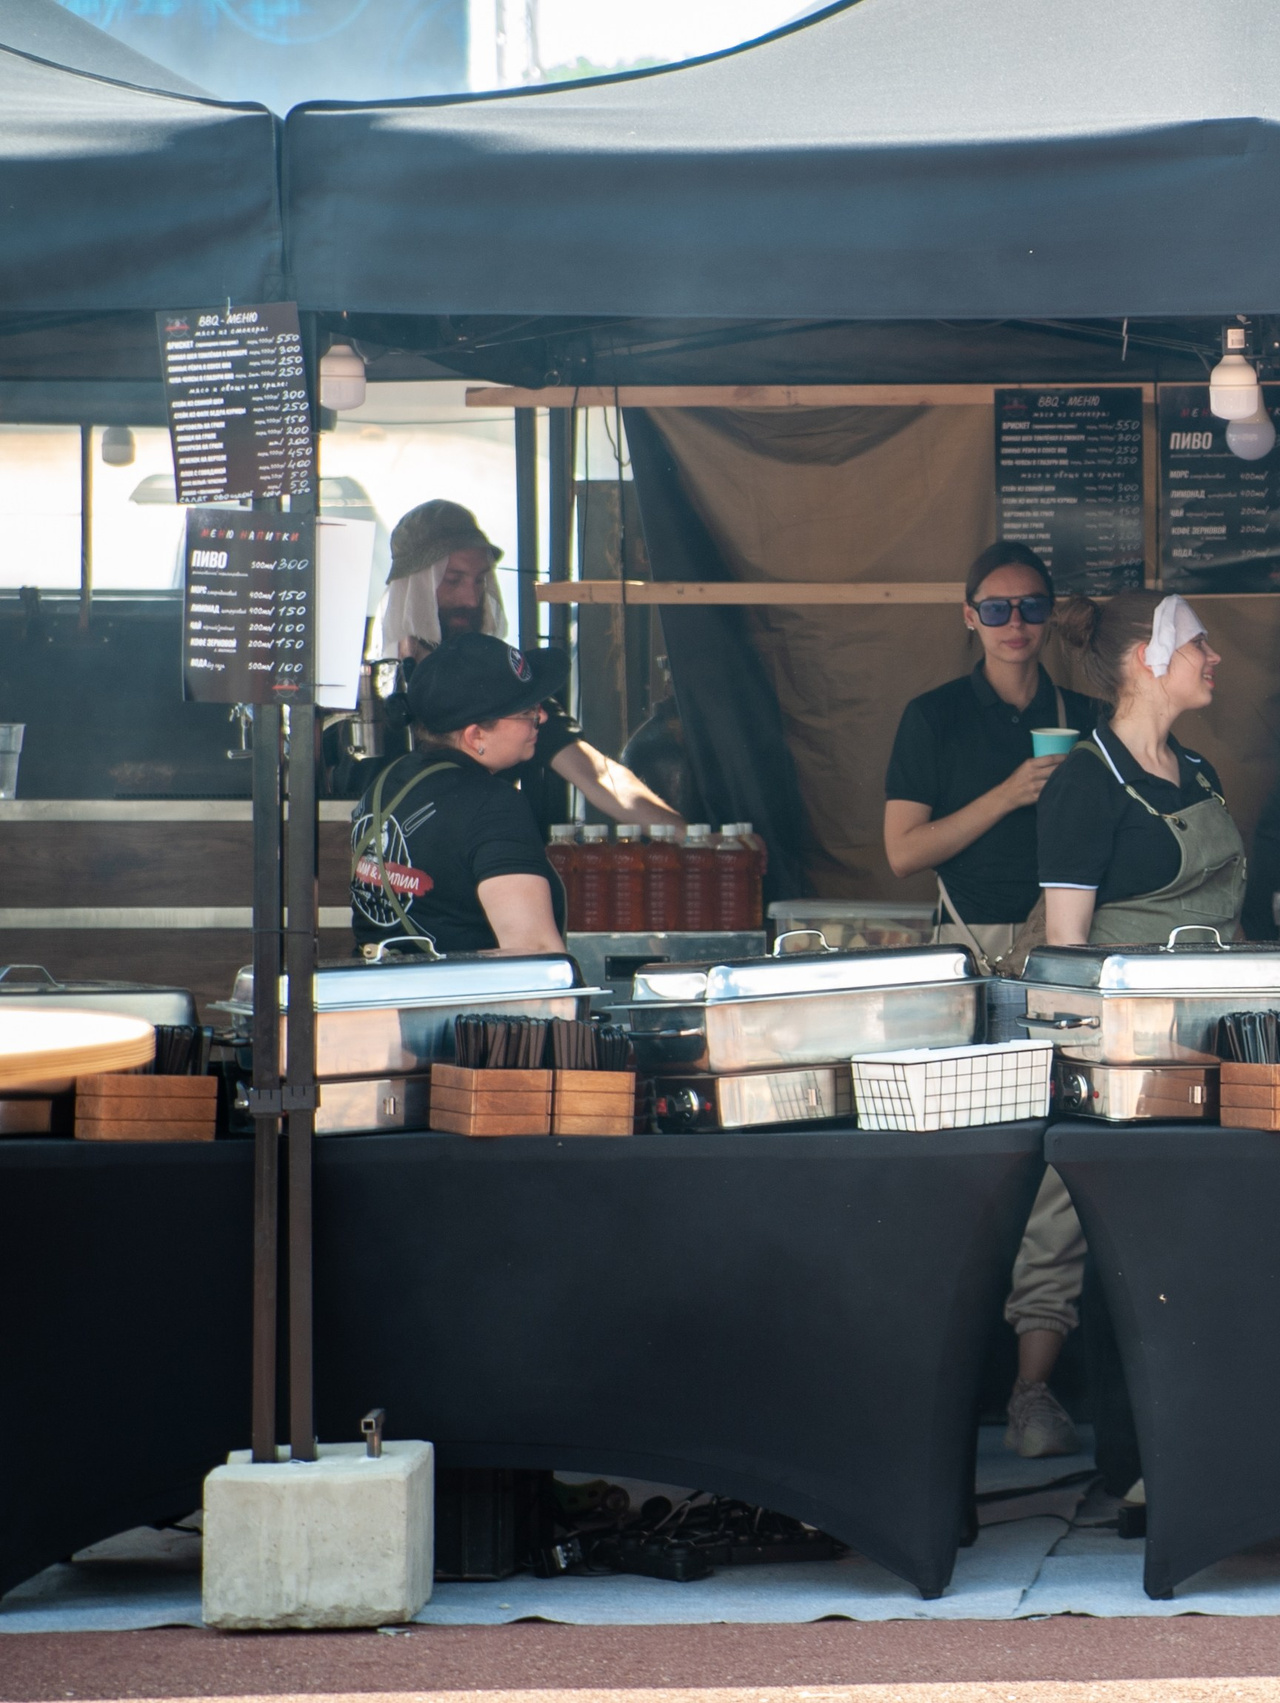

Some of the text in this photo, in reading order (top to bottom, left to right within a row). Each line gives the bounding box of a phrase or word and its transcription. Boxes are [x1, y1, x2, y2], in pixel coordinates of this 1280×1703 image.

[198, 312, 258, 328] BBQ МЕНЮ
[276, 333, 300, 344] 550
[278, 345, 300, 355] 300
[278, 356, 303, 366] 250
[279, 366, 303, 378] 250
[282, 389, 305, 400] 300
[282, 402, 309, 412] 250
[1038, 396, 1100, 408] BBQ МЕНЮ
[284, 415, 306, 425] 150
[1115, 420, 1140, 430] 550
[286, 425, 309, 436] 200
[288, 437, 310, 446] 200
[1171, 432, 1212, 450] ПИВО
[288, 447, 312, 458] 450
[1115, 447, 1138, 455] 250
[288, 459, 310, 469] 400
[1116, 456, 1138, 465] 250
[290, 470, 308, 479] 50
[1170, 470, 1189, 479] МОРС
[290, 480, 308, 490] 50
[1118, 484, 1139, 492] 300
[1171, 490, 1206, 499] ЛИМОНАД
[201, 529, 299, 543] МЕНЮ НАПИТКИ
[1171, 527, 1190, 535] КОФЕ
[192, 550, 228, 569] ПИВО
[278, 558, 309, 571] 300
[278, 590, 306, 602] 150
[278, 605, 306, 617] 150
[278, 623, 305, 633] 100
[276, 638, 304, 649] 150
[278, 662, 303, 673] 100
